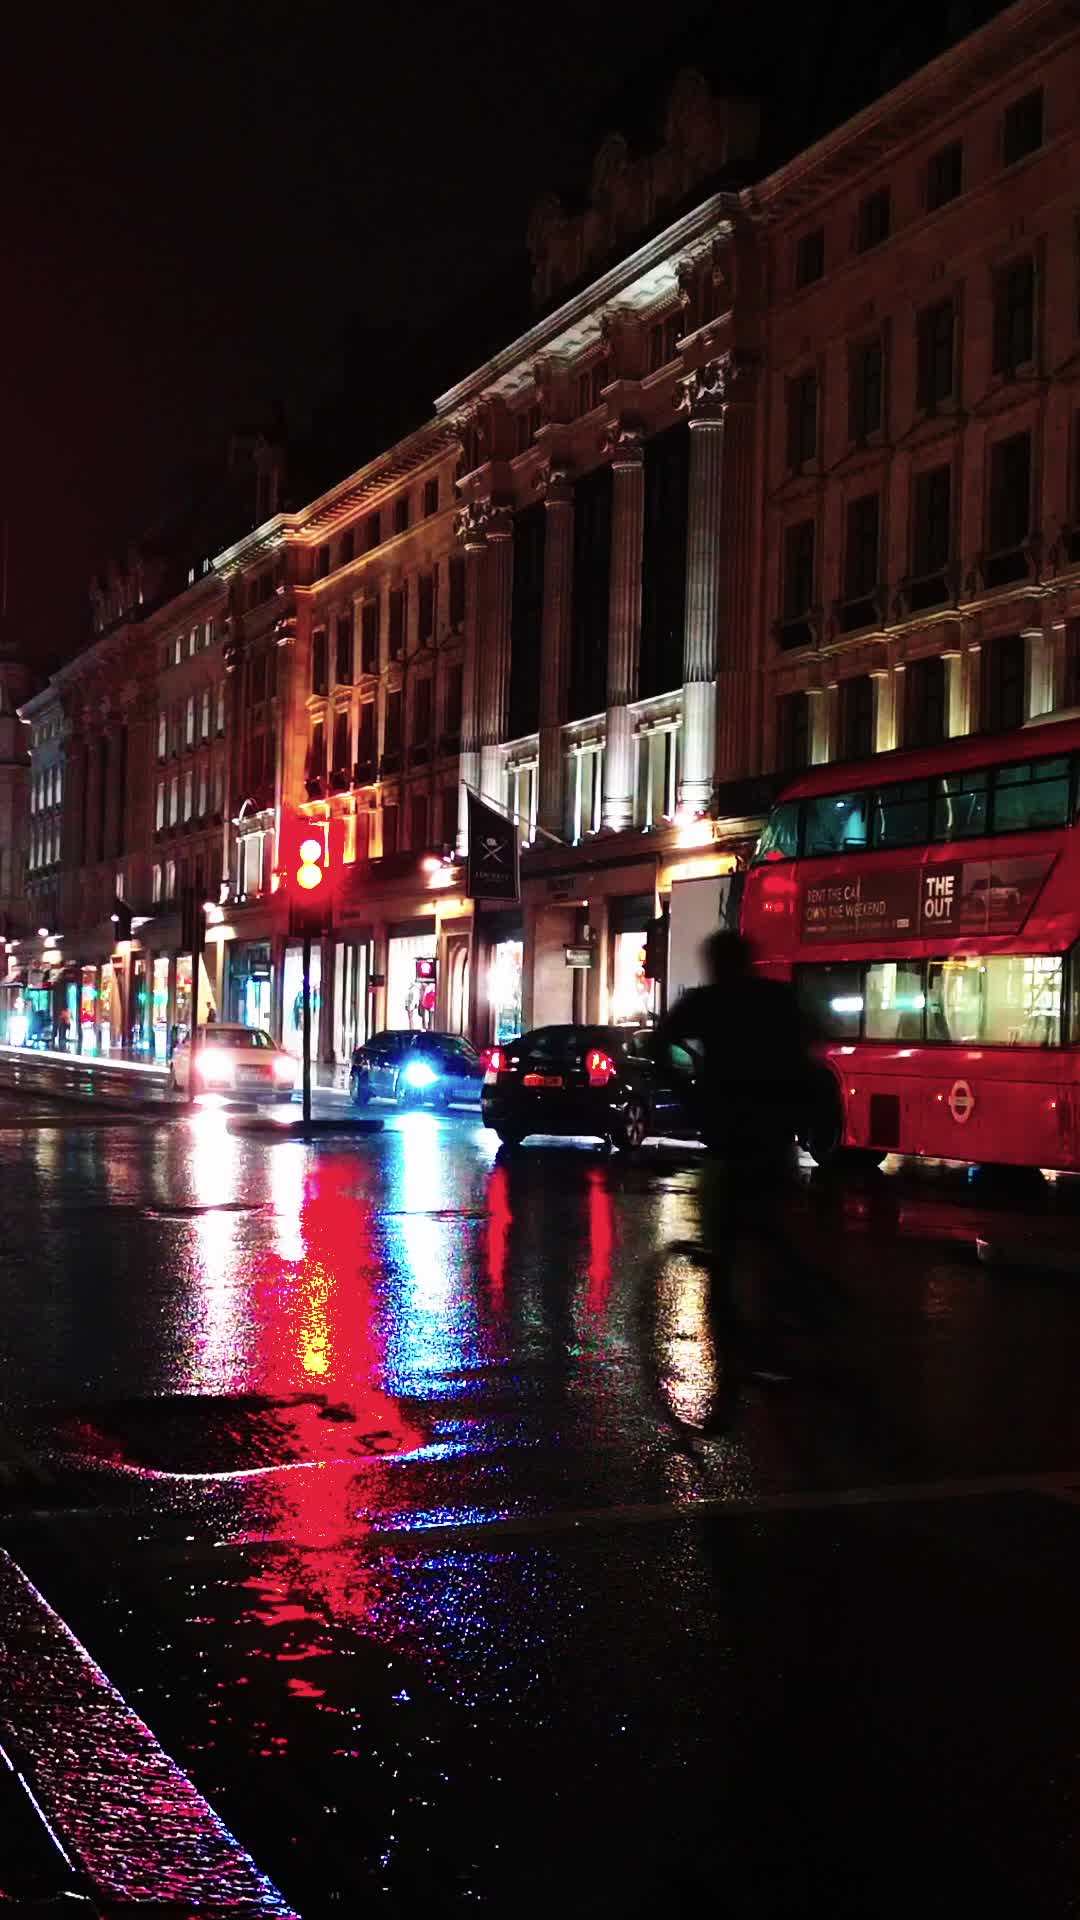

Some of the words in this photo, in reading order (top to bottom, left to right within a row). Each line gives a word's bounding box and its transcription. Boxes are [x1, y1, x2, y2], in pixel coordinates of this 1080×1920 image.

[807, 888, 826, 904] RENT
[827, 887, 842, 902] THE
[926, 875, 954, 896] THE
[807, 906, 826, 920] OWN
[828, 904, 843, 918] THE
[845, 900, 887, 918] WEEKEND
[924, 897, 953, 918] OUT
